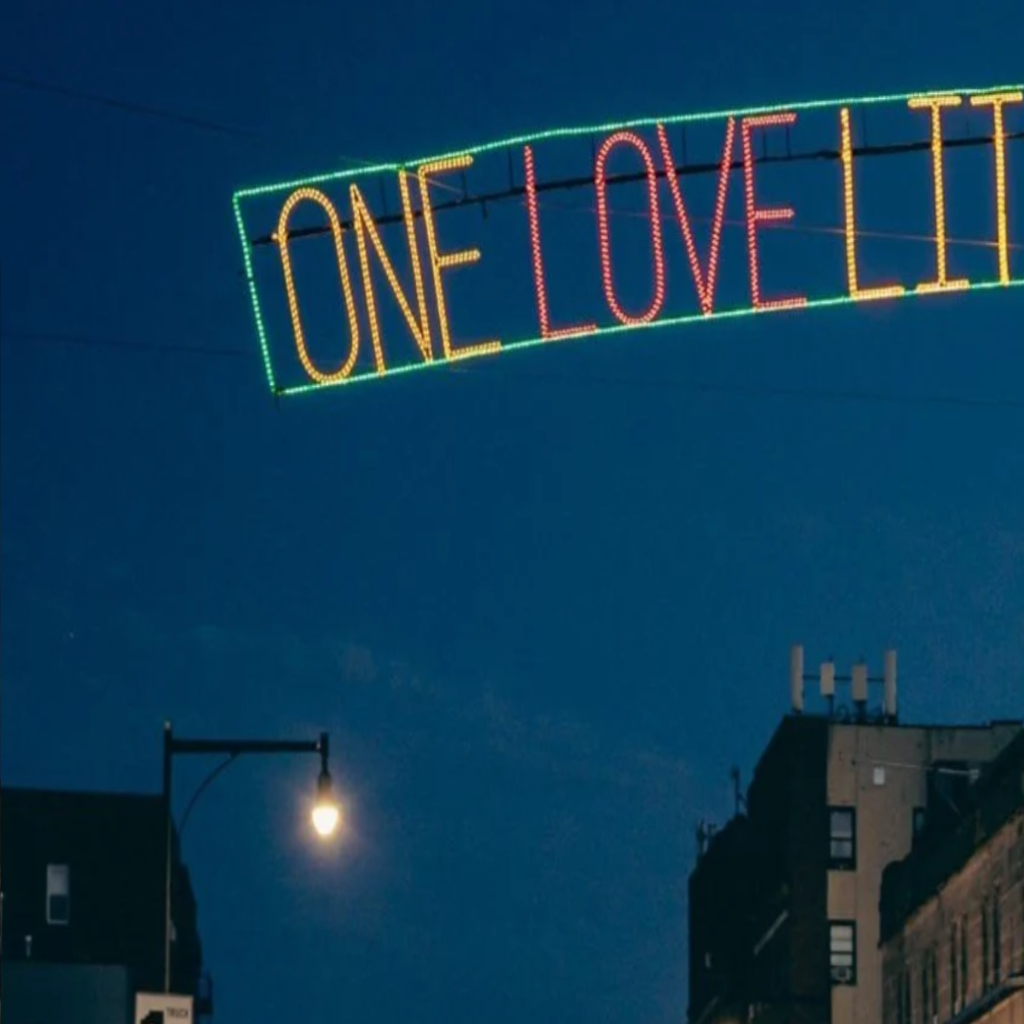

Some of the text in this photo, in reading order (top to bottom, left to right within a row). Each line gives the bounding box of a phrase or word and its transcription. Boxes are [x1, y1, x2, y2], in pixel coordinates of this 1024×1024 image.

[274, 154, 501, 385] ONE
[524, 111, 807, 340] LOVE
[165, 1006, 190, 1019] TRUCK
